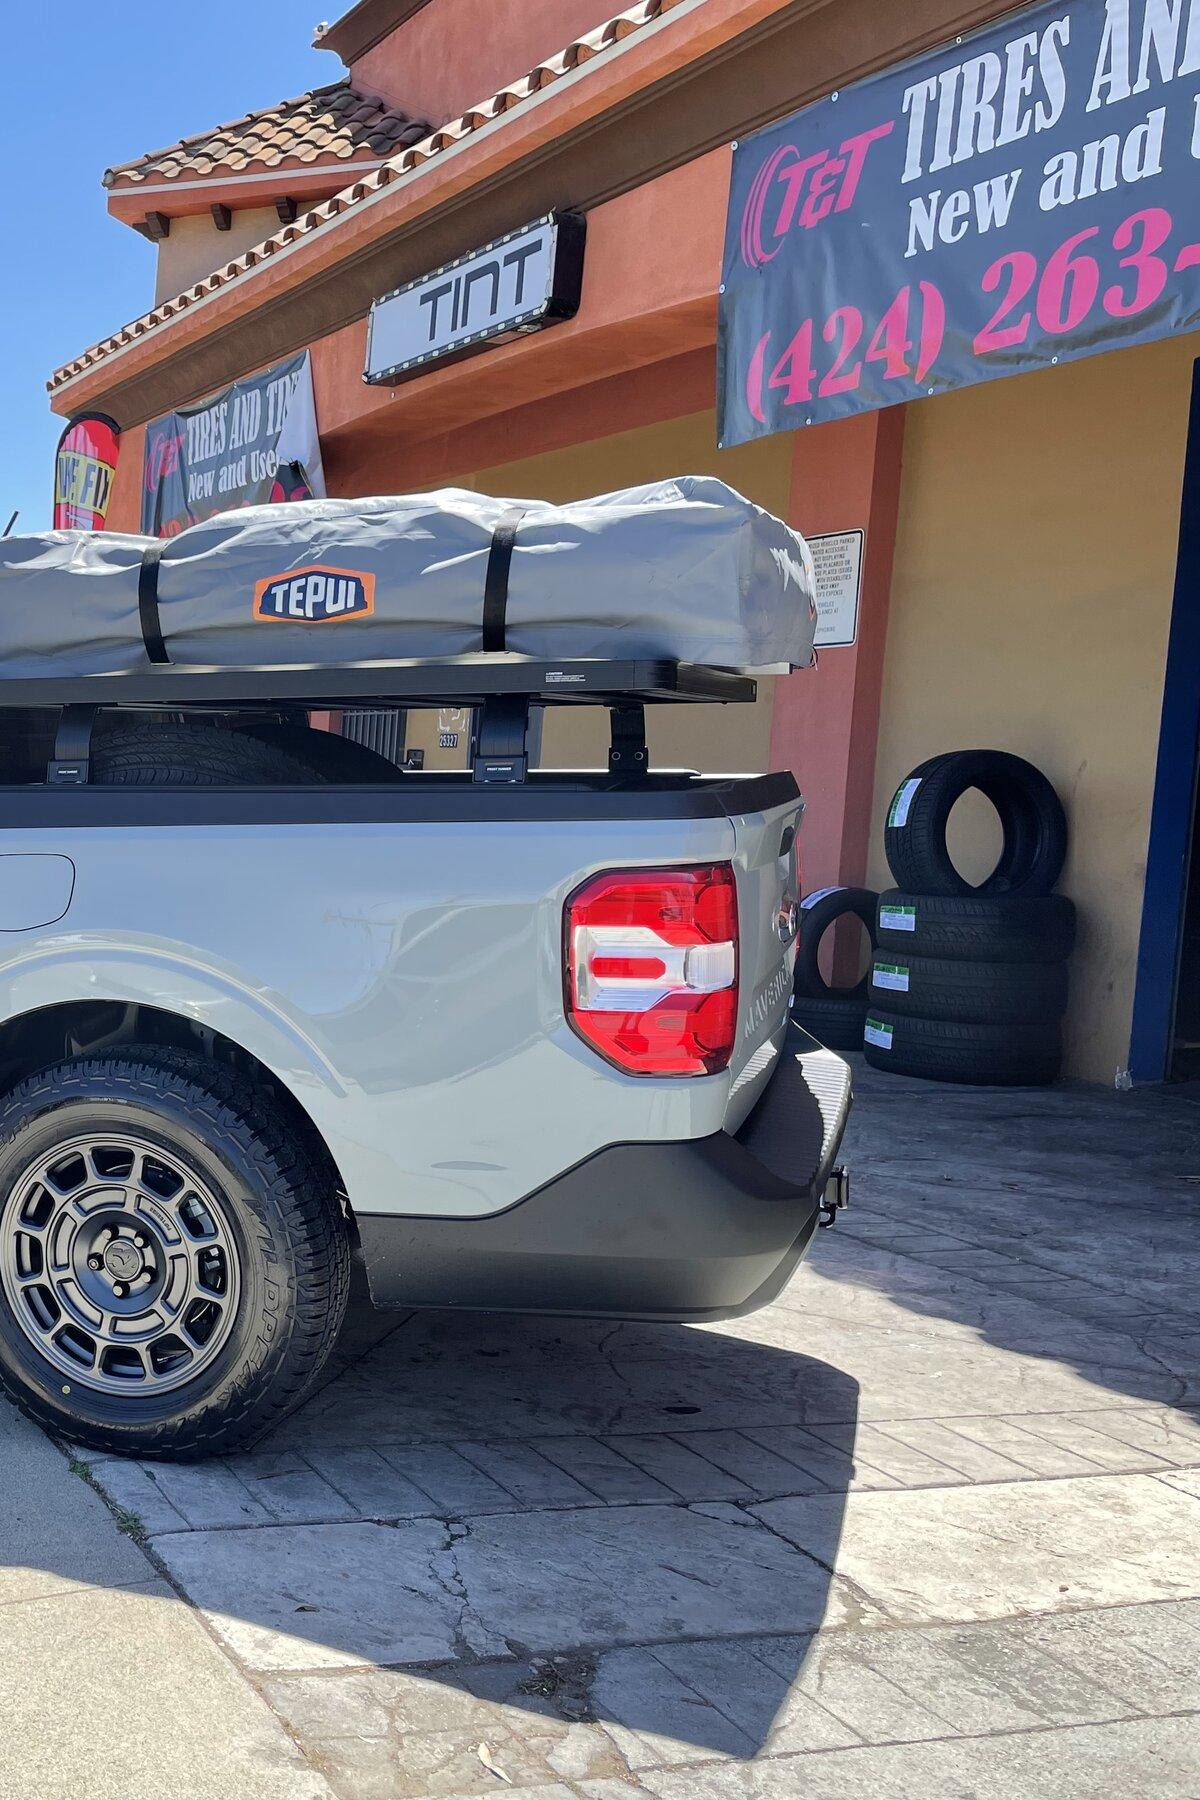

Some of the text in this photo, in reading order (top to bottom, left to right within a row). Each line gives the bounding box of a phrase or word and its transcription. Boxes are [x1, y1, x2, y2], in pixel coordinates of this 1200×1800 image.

[901, 15, 1070, 184] TIRES
[773, 120, 895, 239] T&T
[904, 168, 1022, 259] New
[1039, 106, 1166, 211] and
[419, 238, 543, 342] TINT
[746, 280, 946, 423] (424)
[186, 401, 228, 466] TIRES
[229, 389, 262, 450] AND
[188, 469, 216, 503] New
[218, 455, 248, 493] and
[271, 575, 356, 618] TEPUI
